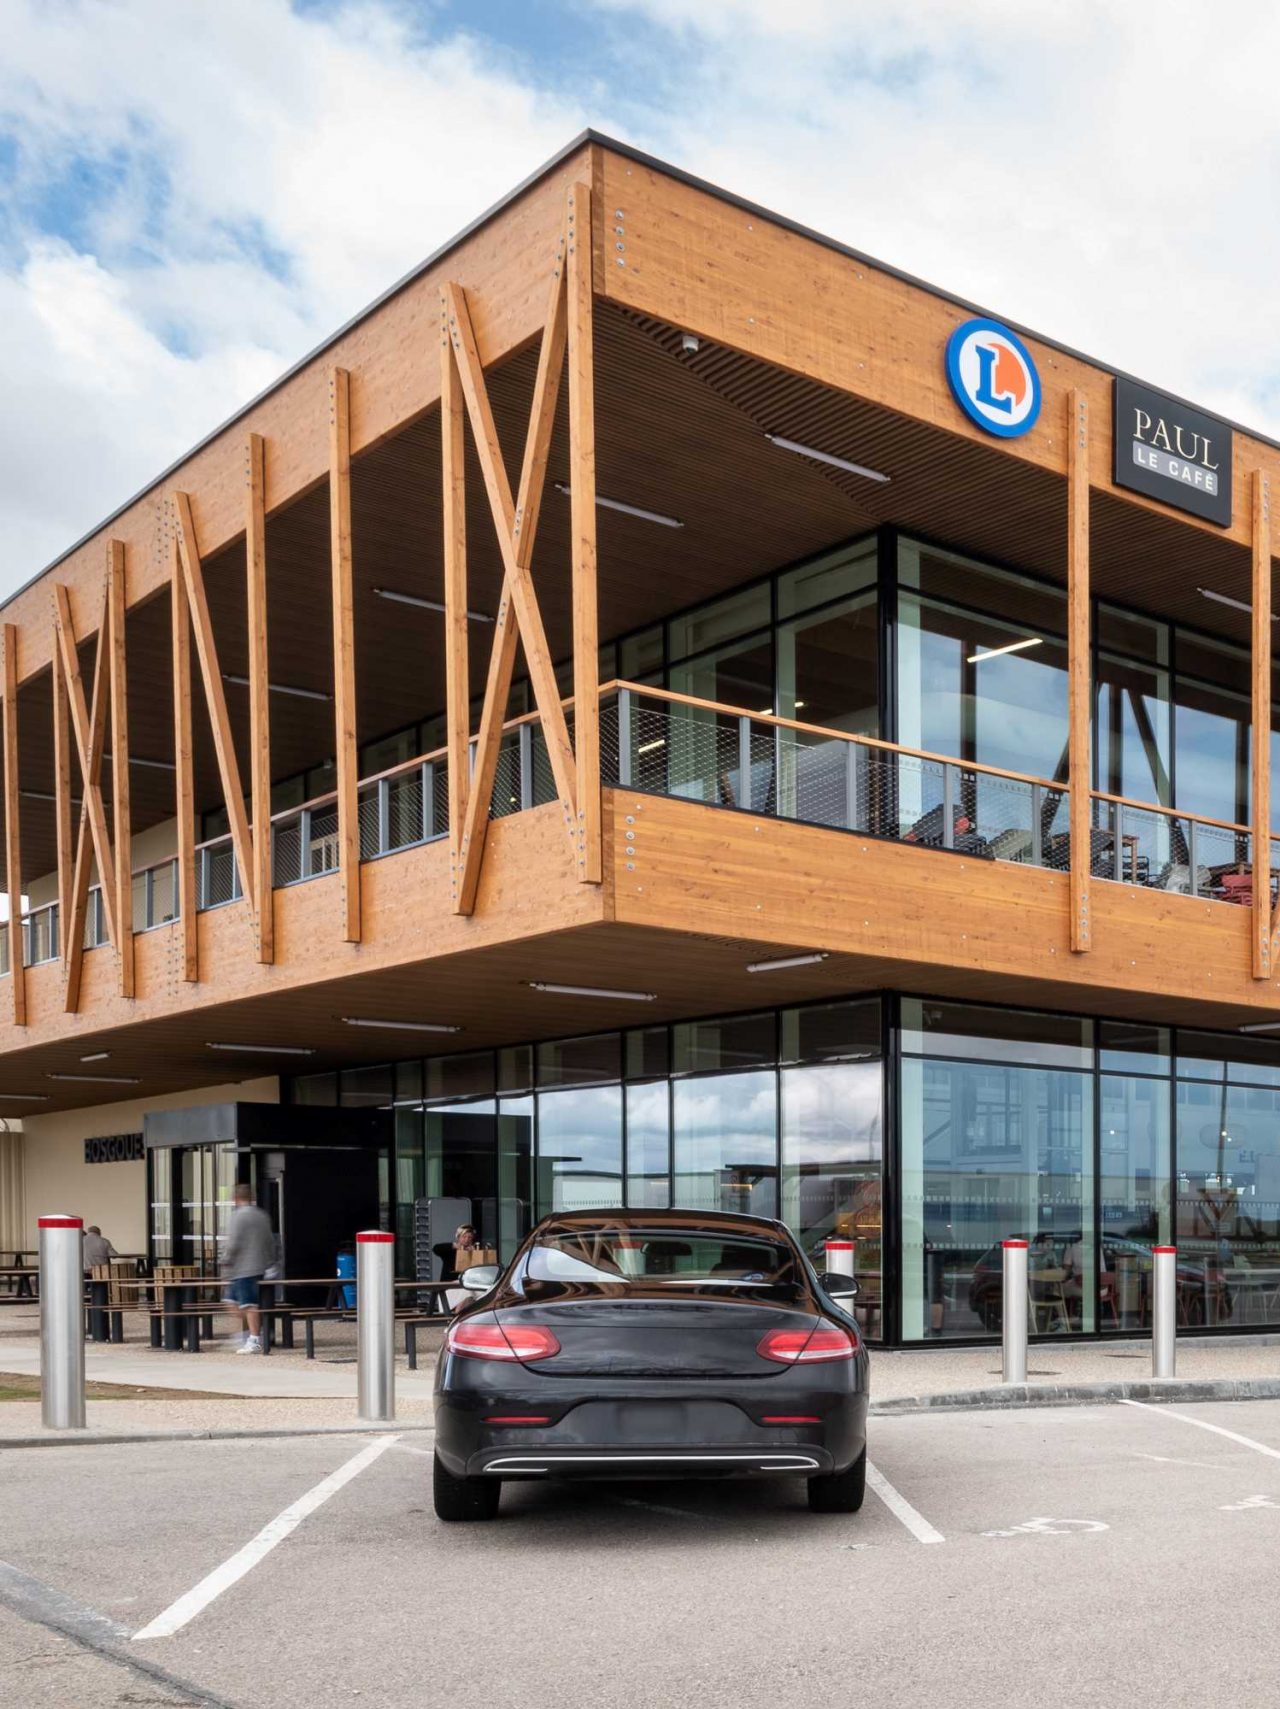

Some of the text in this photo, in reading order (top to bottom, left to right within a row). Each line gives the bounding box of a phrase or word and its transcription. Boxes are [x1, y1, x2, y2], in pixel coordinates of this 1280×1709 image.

[1132, 407, 1219, 470] PAUL
[1137, 447, 1214, 491] LE CAFÉ
[84, 1132, 145, 1164] BOSGOUE
